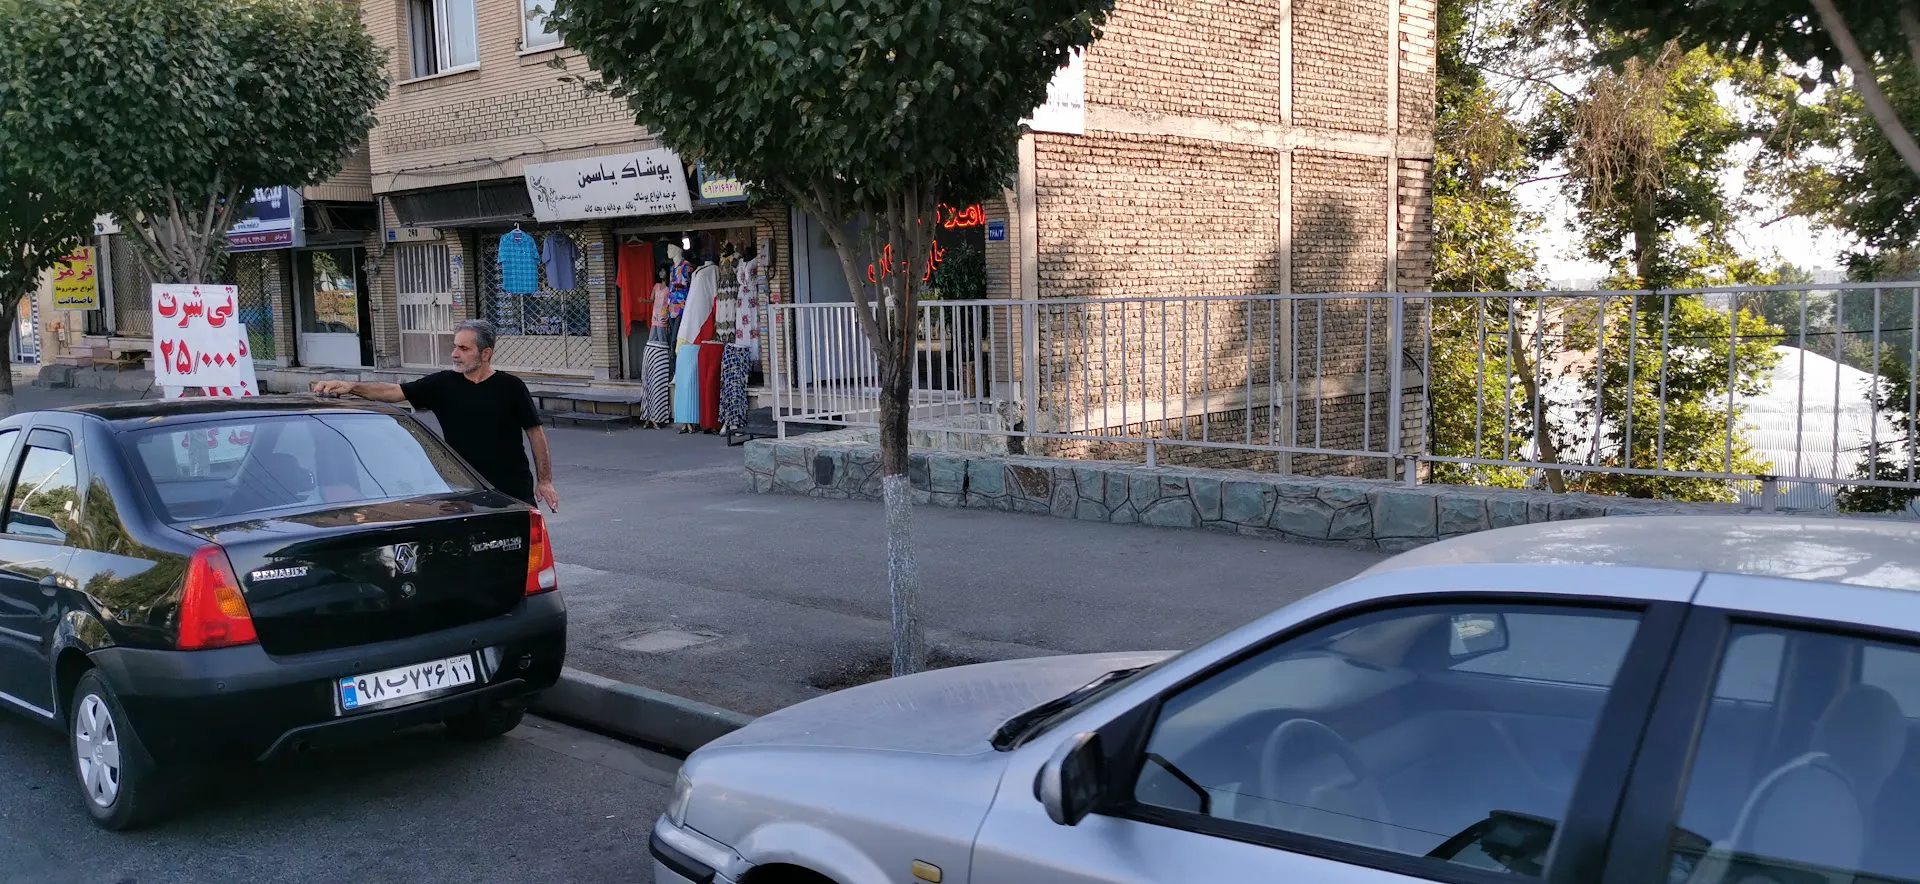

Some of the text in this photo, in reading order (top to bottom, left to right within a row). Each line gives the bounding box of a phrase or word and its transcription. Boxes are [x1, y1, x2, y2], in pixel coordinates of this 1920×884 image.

[578, 156, 672, 188] پوشاک یاسمن
[55, 264, 93, 281] ترمز
[157, 286, 234, 328] تی شرت
[160, 339, 237, 374] ۲۵/۰۰۰
[252, 566, 308, 581] RENAULT
[452, 663, 471, 682] ۱۱
